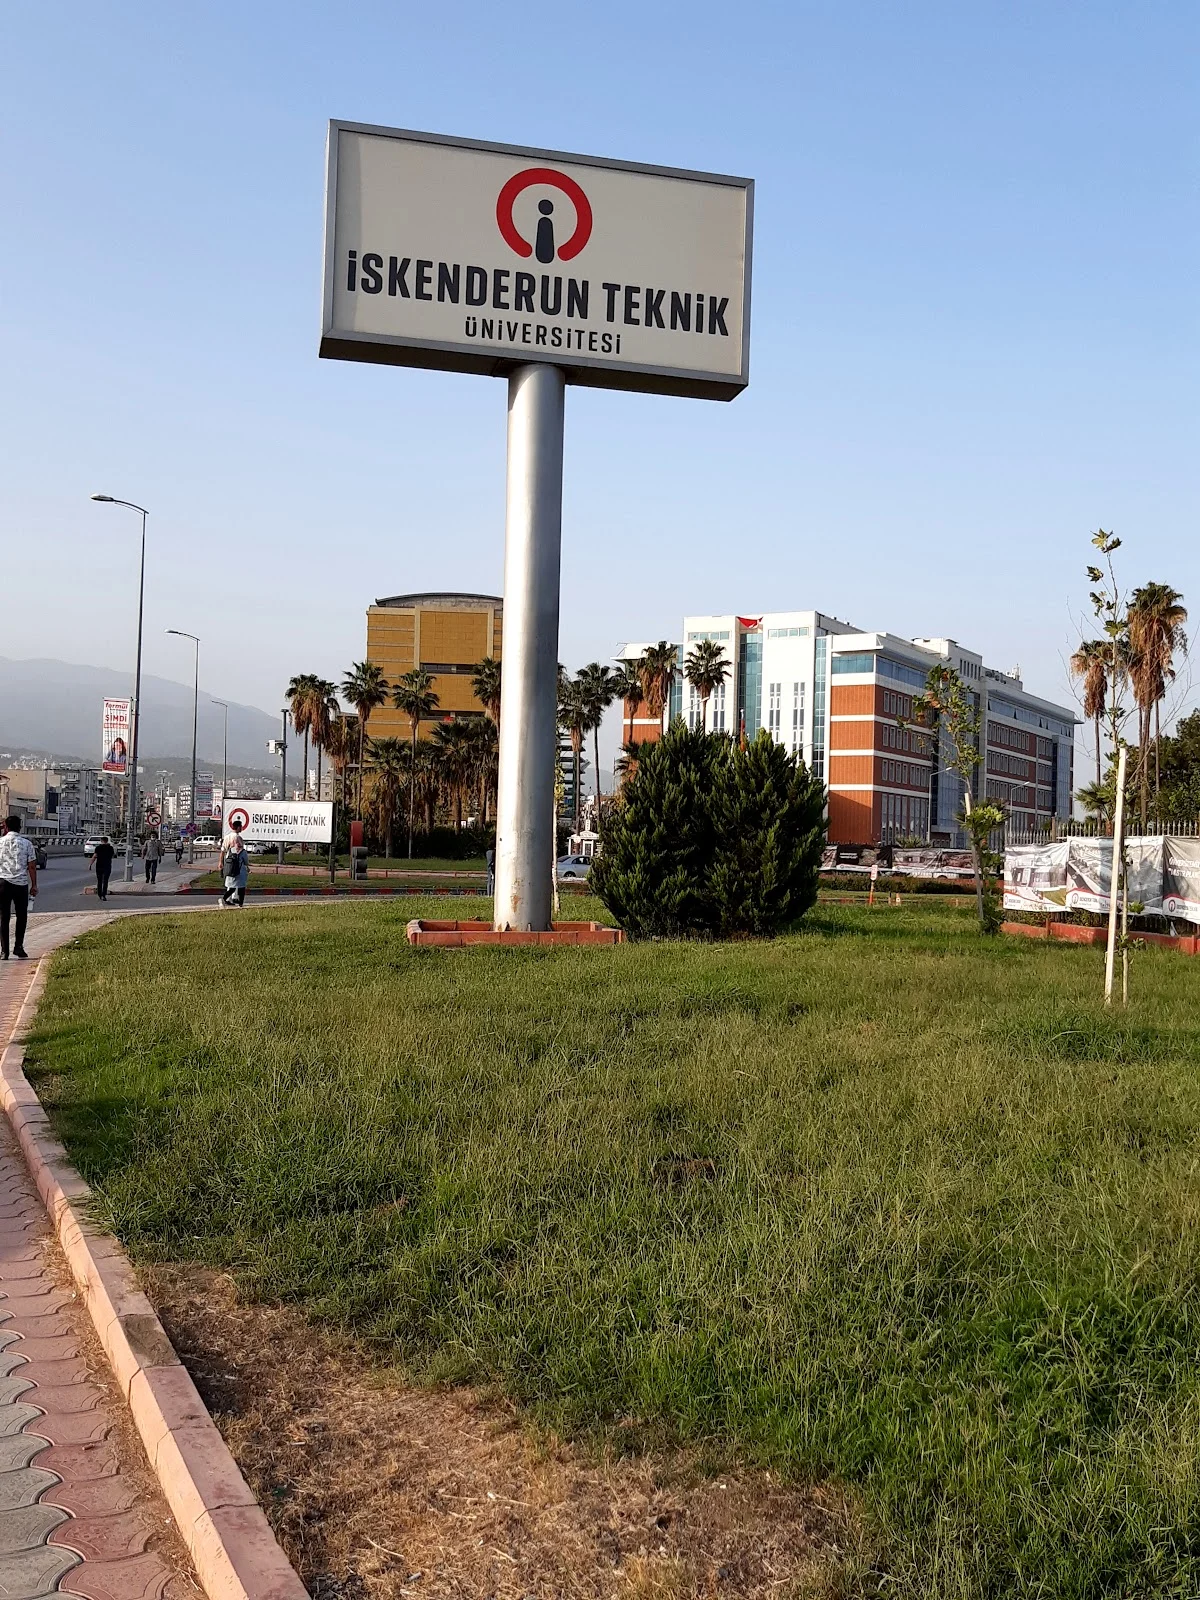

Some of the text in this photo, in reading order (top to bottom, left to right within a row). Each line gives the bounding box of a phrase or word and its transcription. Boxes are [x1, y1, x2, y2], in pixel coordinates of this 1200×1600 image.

[347, 250, 729, 336] İSKENDERUN TEKNİK
[465, 317, 621, 354] ÜNİVERSİTESİ
[105, 713, 127, 722] ŞİMDİ
[252, 813, 326, 826] İSKENDERUN TEKNİK
